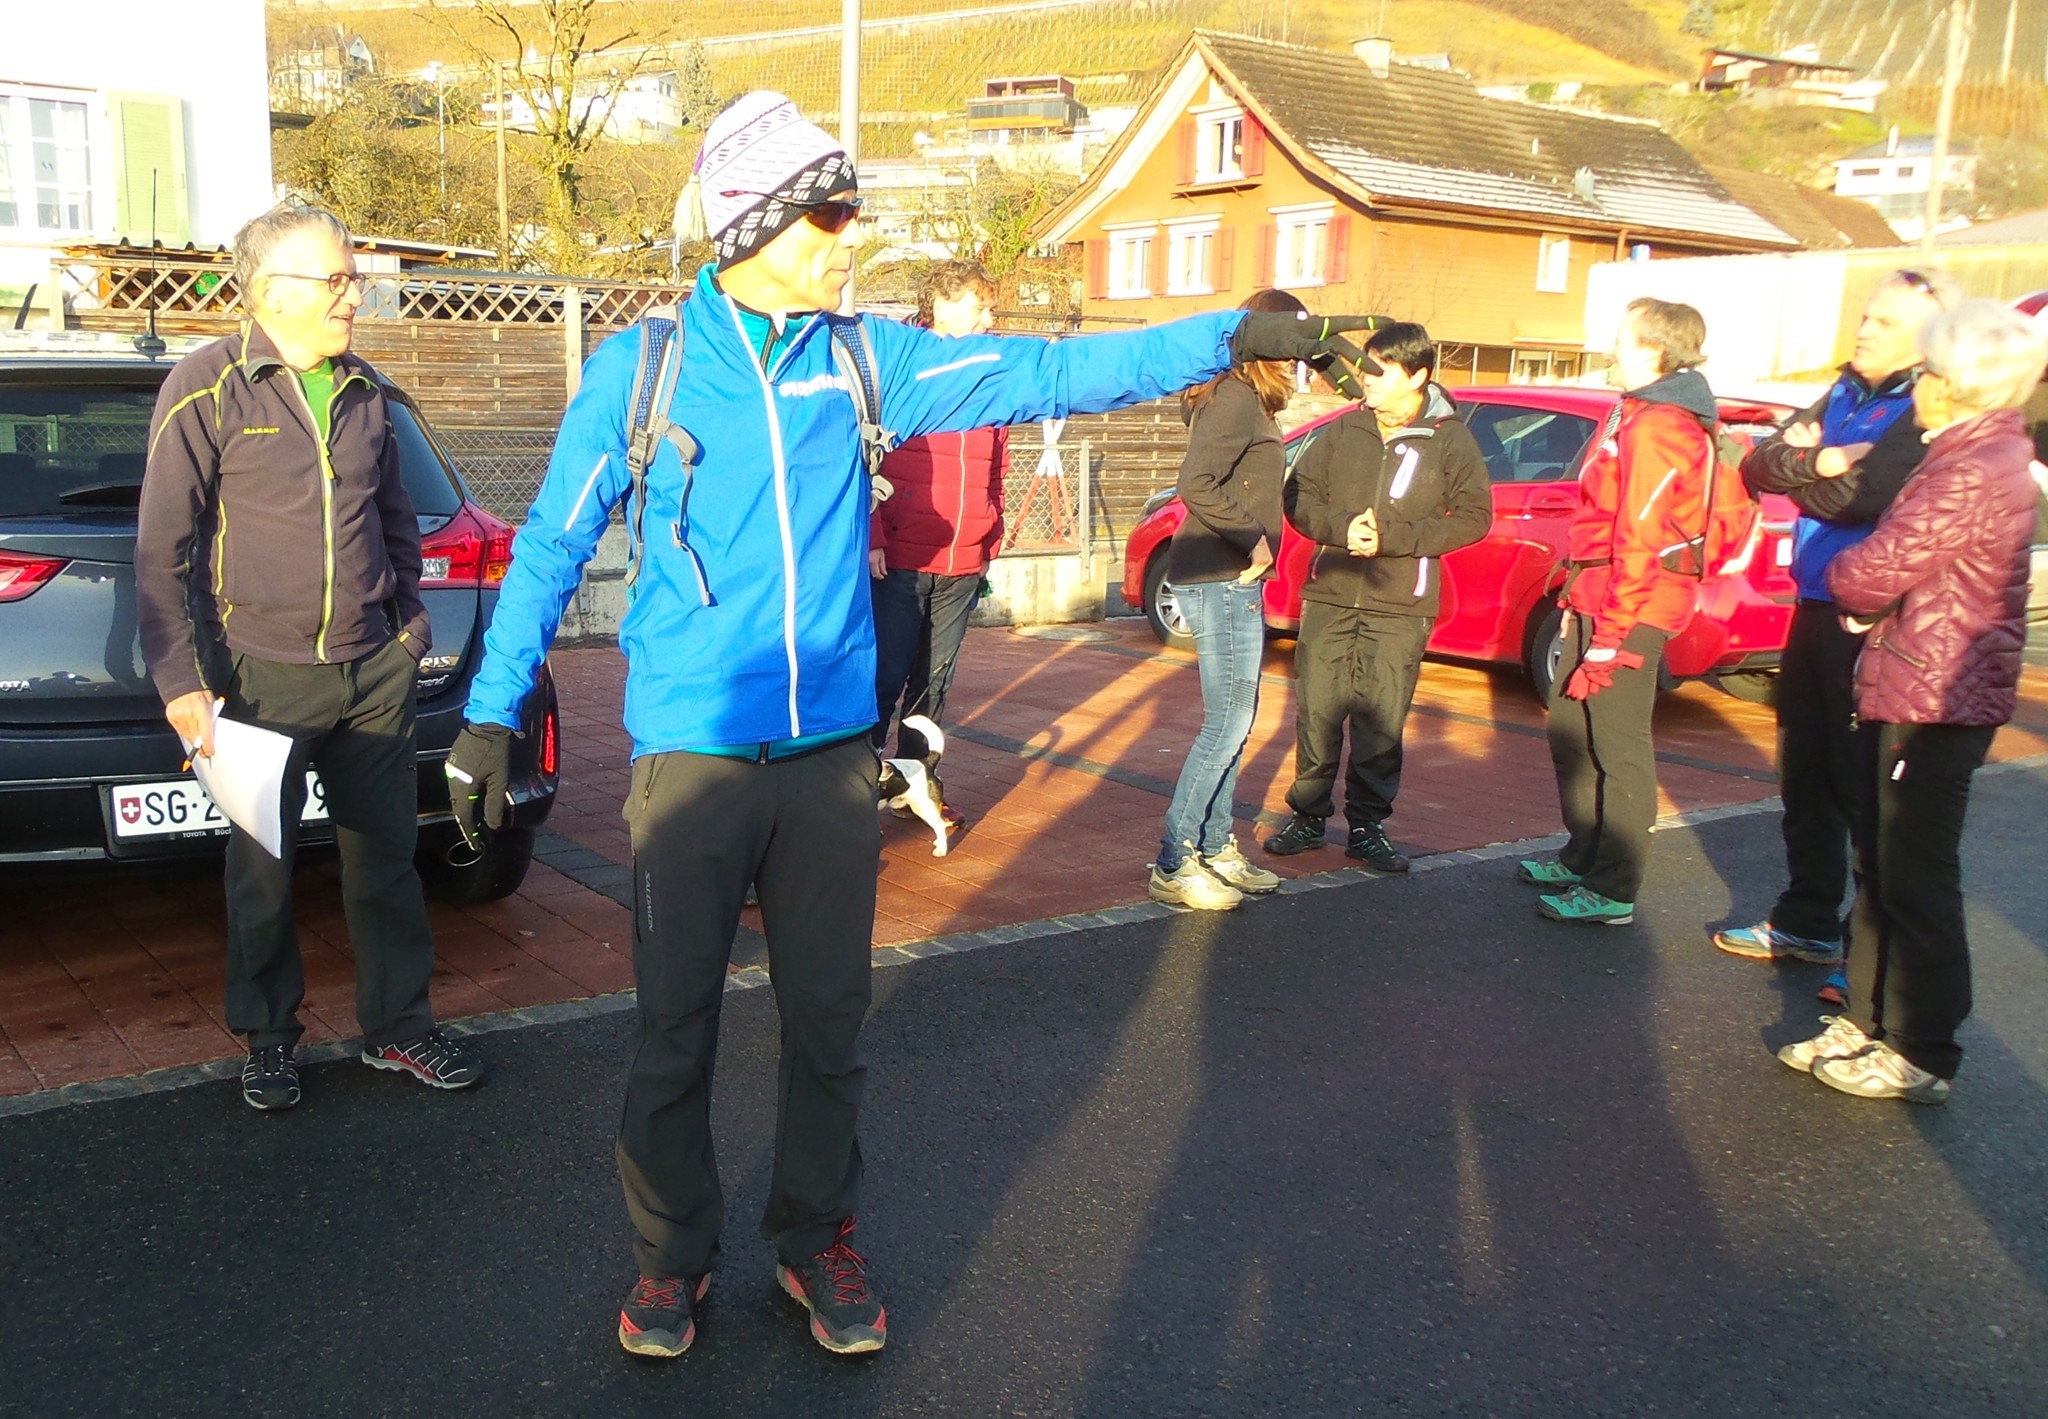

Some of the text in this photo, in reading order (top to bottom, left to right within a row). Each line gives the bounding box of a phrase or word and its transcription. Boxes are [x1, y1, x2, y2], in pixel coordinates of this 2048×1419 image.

[243, 427, 280, 435] MAMMUT
[419, 655, 451, 669] RIS
[0, 680, 32, 692] OTA
[644, 869, 655, 933] SALOMON
